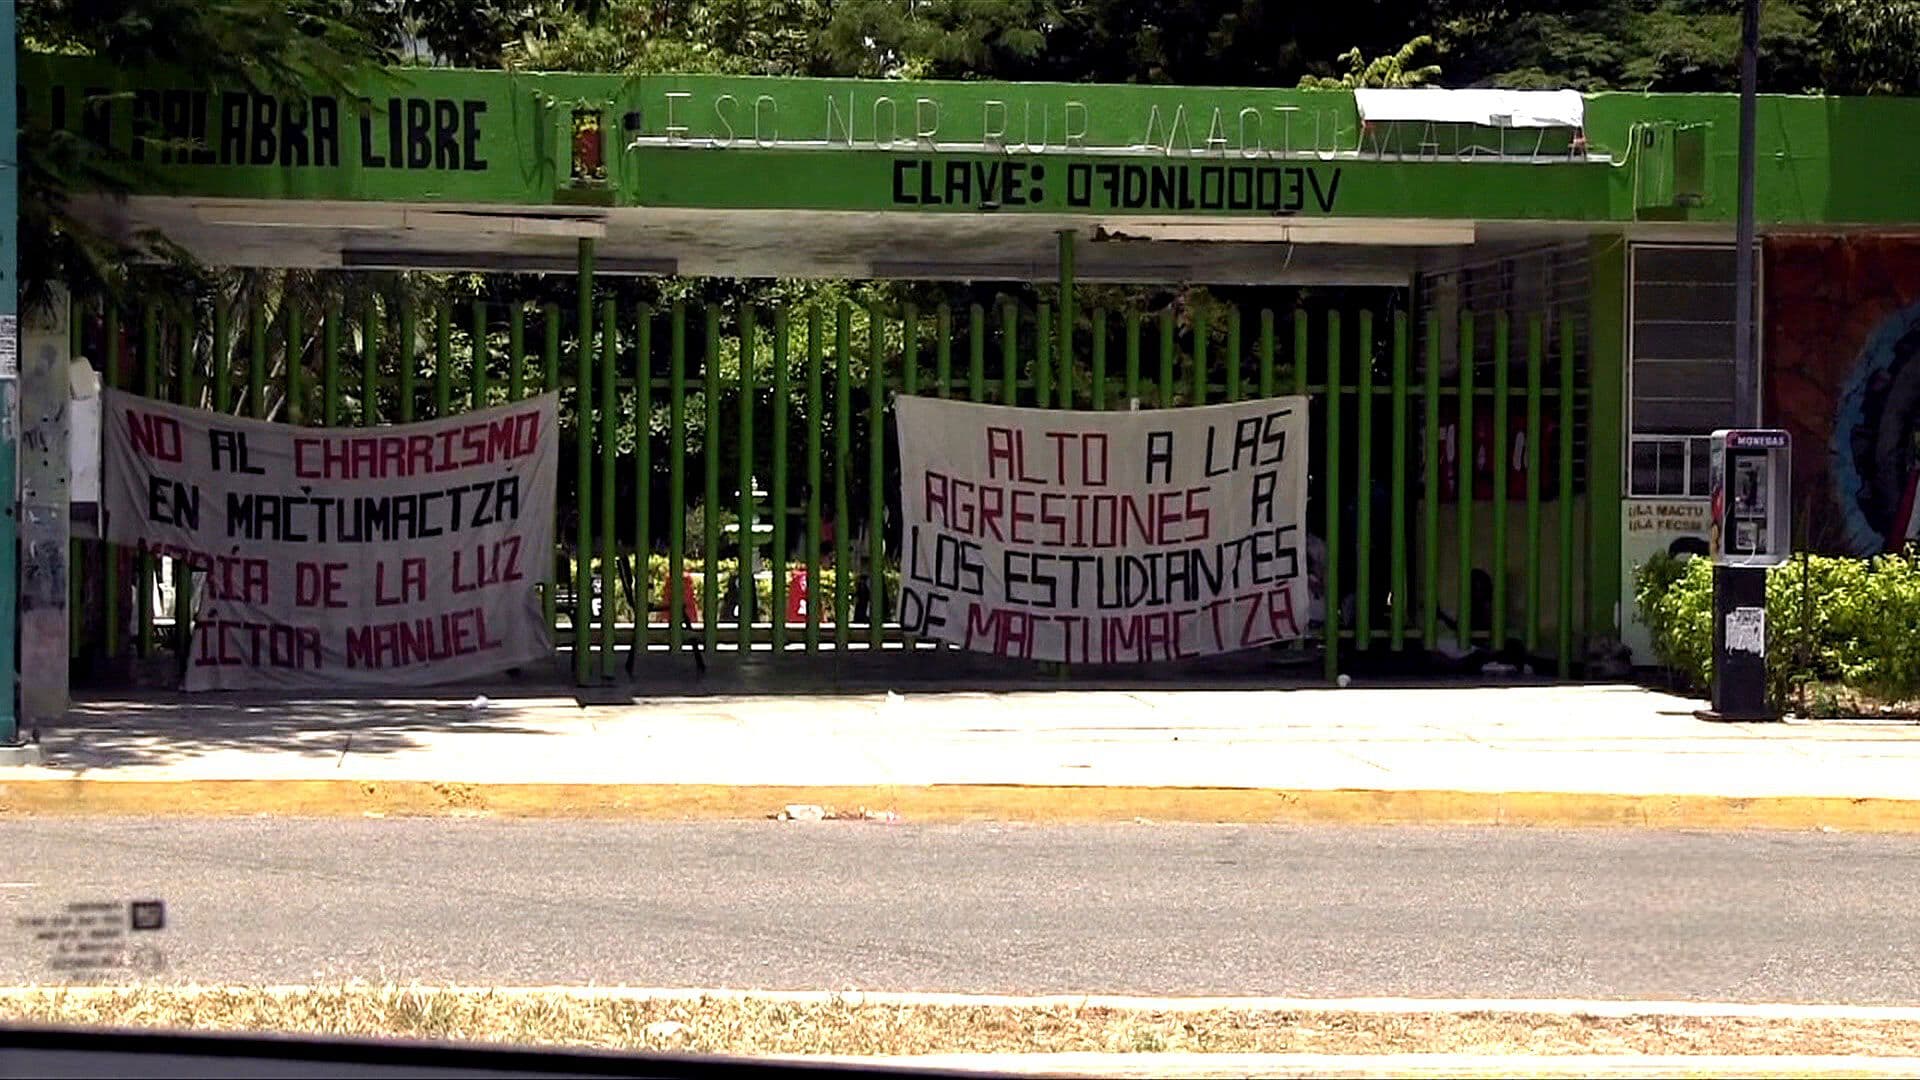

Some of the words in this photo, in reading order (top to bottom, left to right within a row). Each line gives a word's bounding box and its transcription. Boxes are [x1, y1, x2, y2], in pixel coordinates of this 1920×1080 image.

[132, 89, 339, 168] PALABRA
[360, 98, 488, 171] LIBRE
[826, 90, 939, 151] NOR
[893, 160, 1045, 206] CLAVE:
[126, 408, 183, 464] NO
[208, 428, 265, 475] AL
[293, 410, 541, 480] CHARRISMO
[986, 427, 1108, 486] ALTO
[1146, 431, 1173, 483] A
[1204, 409, 1293, 478] LAS
[148, 474, 200, 532] EN
[925, 469, 1212, 548] AGRESIONES
[1251, 471, 1277, 526] A
[295, 561, 348, 608] DE
[375, 557, 427, 606] LA
[451, 535, 523, 595] LUZ
[910, 525, 984, 595] LOS
[1003, 524, 1299, 610] ESTUDIANTES
[346, 607, 502, 671] MANUEL
